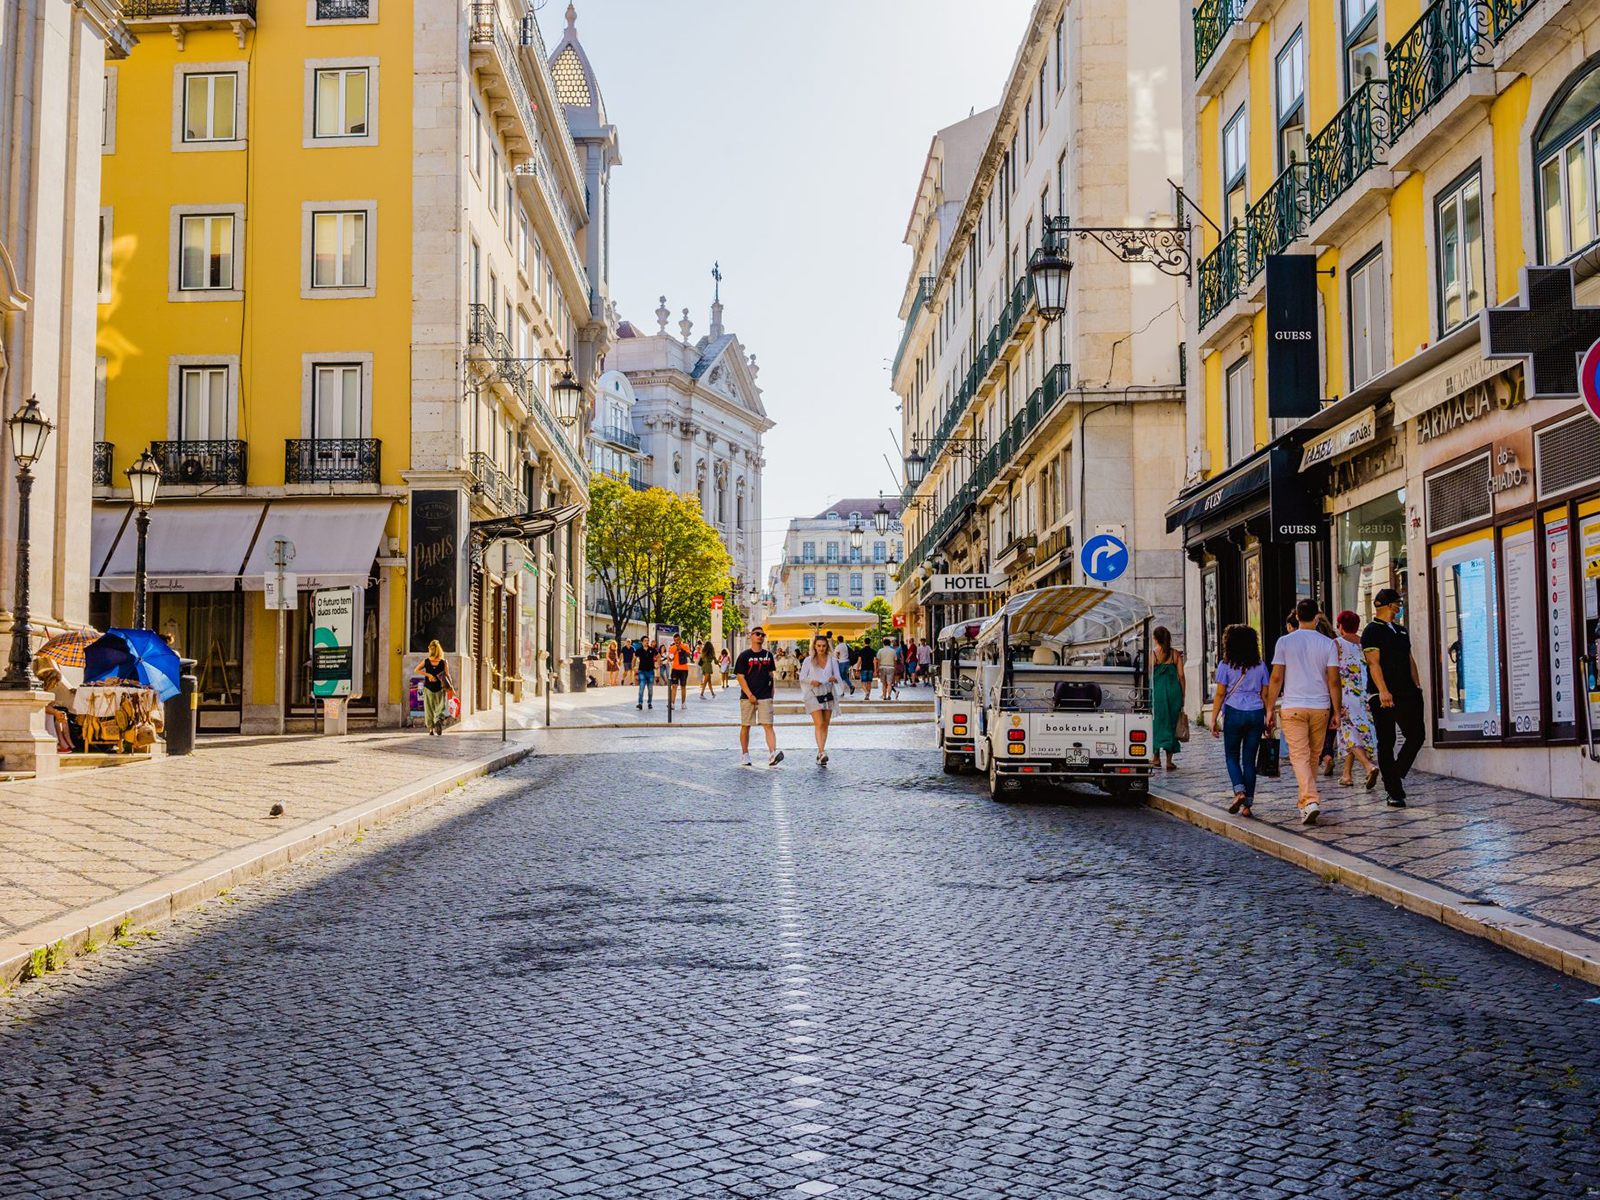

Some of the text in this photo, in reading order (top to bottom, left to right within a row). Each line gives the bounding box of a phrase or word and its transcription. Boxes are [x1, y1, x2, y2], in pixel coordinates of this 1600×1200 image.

[1274, 331, 1312, 340] GUESS
[1416, 384, 1491, 445] FARMACIA
[1497, 445, 1508, 466] do
[1487, 468, 1522, 494] CHIADO
[1279, 525, 1317, 534] GUESS
[413, 534, 454, 582] PARIS
[944, 577, 992, 589] HOTEL
[318, 596, 352, 606] O futuro tem
[318, 606, 349, 616] duas rodas.
[1046, 724, 1109, 733] bookatuk.pt
